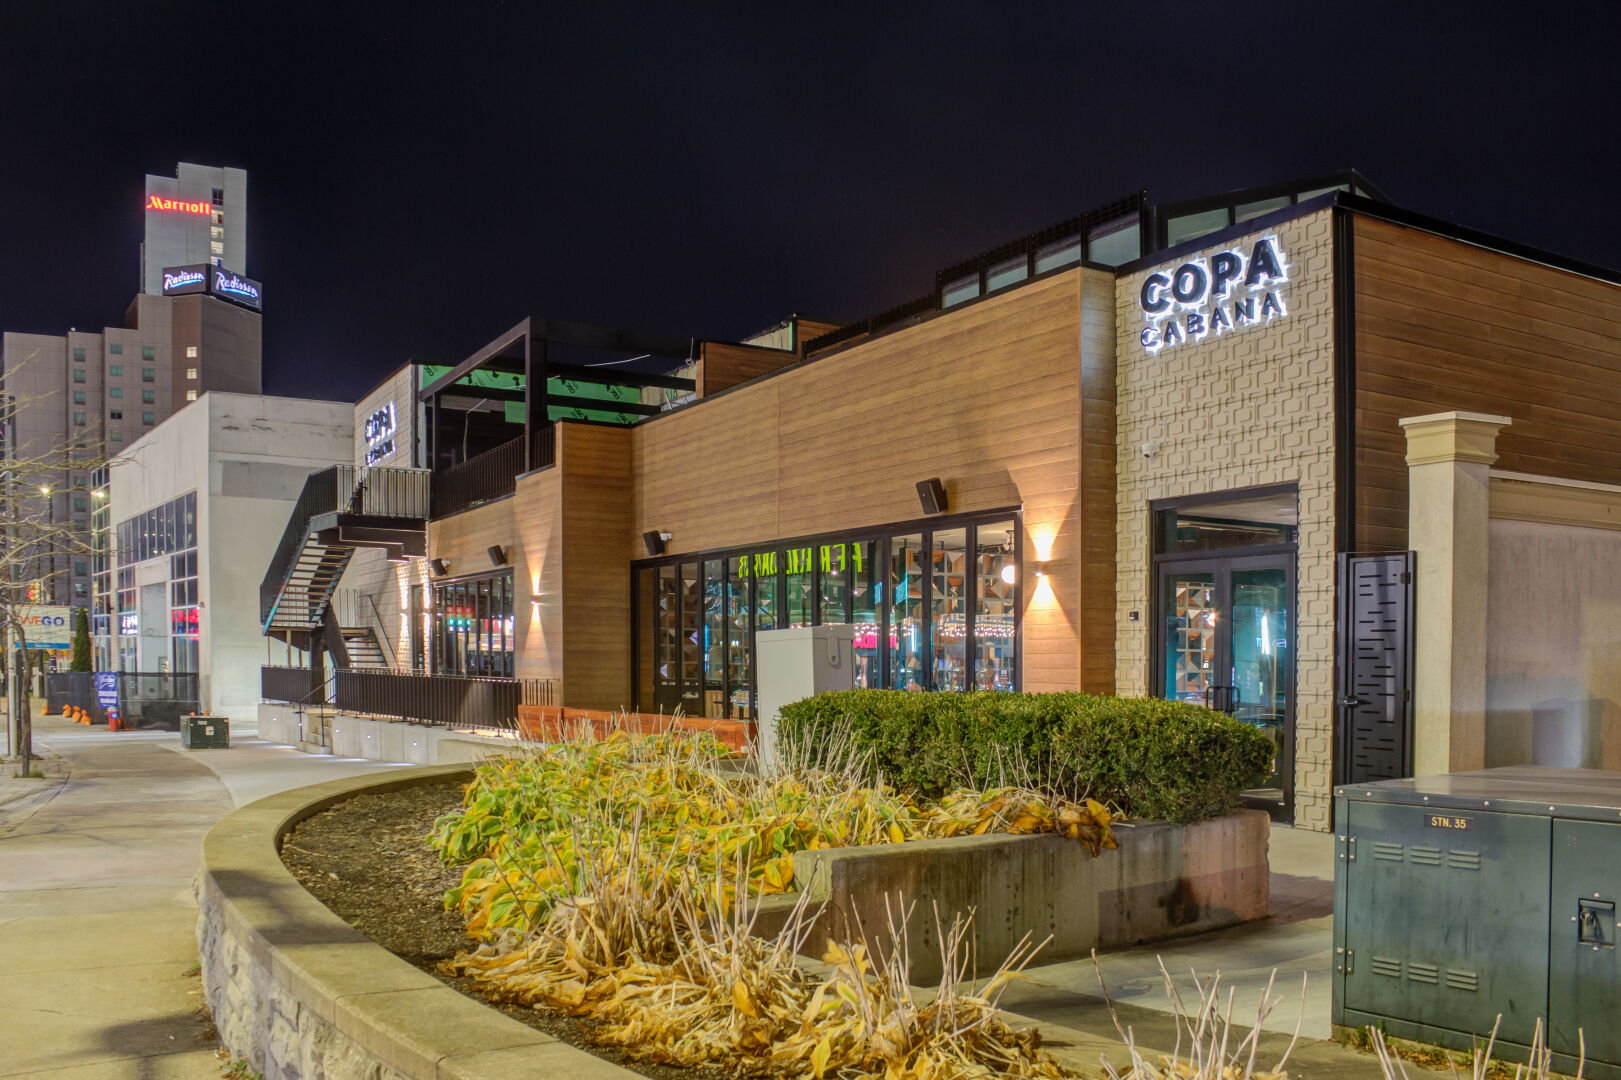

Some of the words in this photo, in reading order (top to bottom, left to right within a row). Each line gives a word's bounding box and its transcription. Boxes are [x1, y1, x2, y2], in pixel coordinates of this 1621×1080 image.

[146, 195, 211, 215] Marriott
[164, 271, 205, 290] Radisson
[216, 271, 259, 298] Radisson
[1140, 236, 1287, 315] COPA
[1140, 291, 1287, 350] CABANA
[18, 615, 65, 627] WEGO
[1431, 816, 1452, 828] STN.
[1454, 818, 1467, 829] 35
